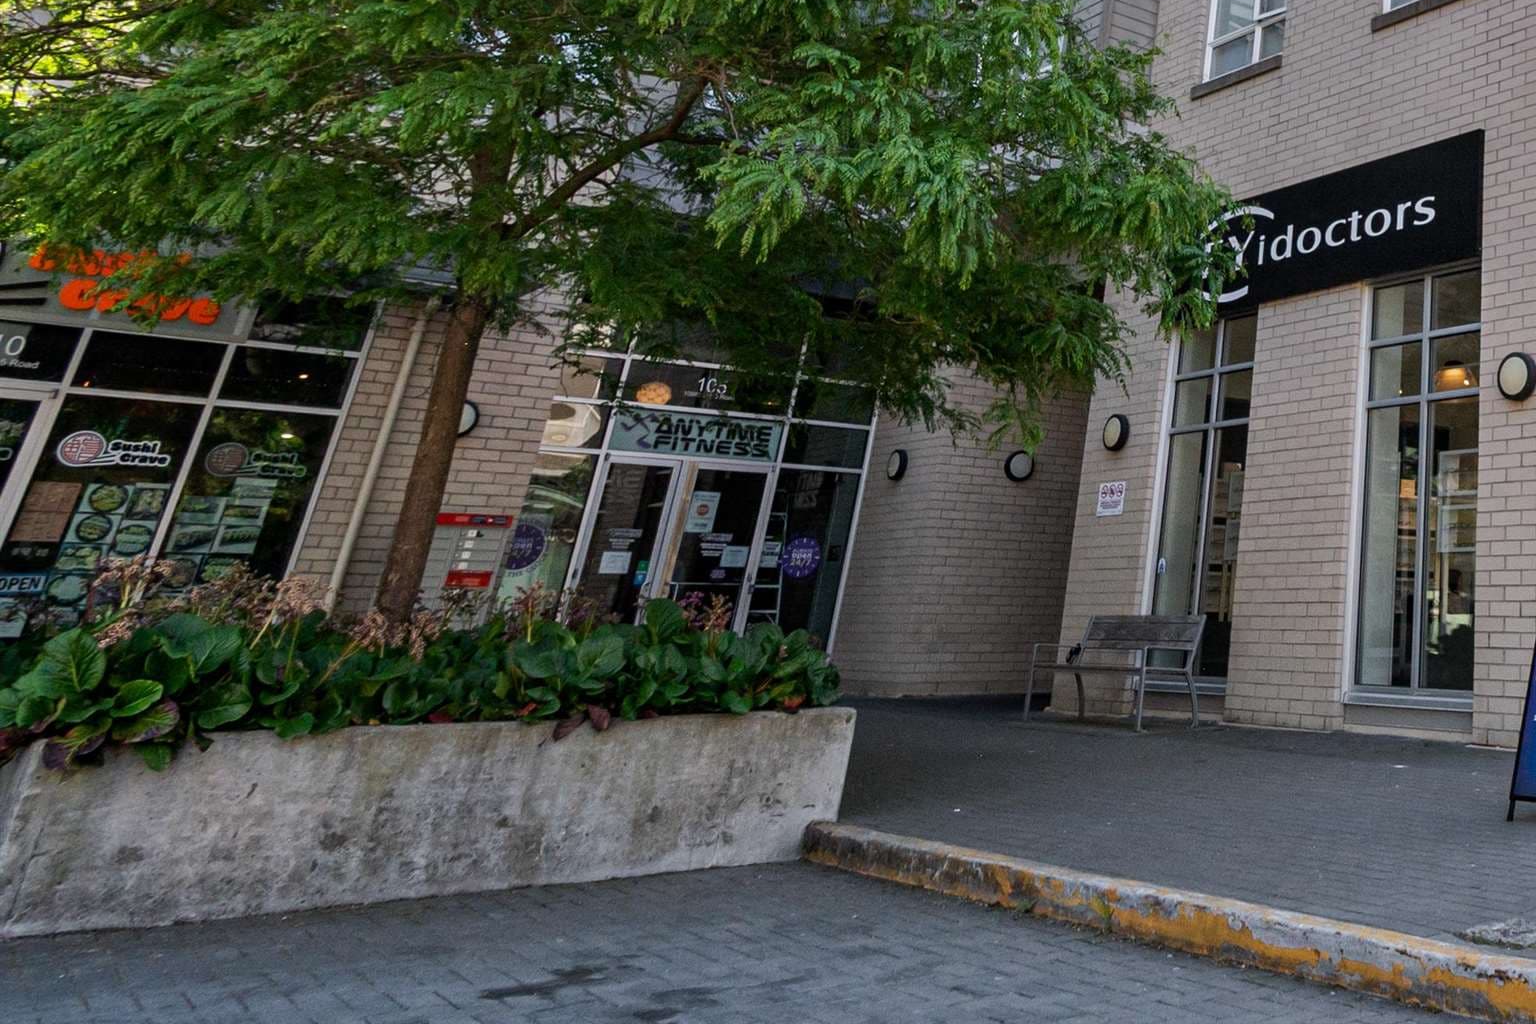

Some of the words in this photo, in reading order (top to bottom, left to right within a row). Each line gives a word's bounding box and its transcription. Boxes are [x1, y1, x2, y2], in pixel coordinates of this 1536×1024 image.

[1202, 195, 1436, 280] Yidoctors
[654, 416, 773, 443] ANYTIME
[110, 441, 157, 454] Sushi
[653, 436, 770, 459] FITNESS
[120, 452, 168, 465] Crave
[0, 577, 41, 591] OPEN
